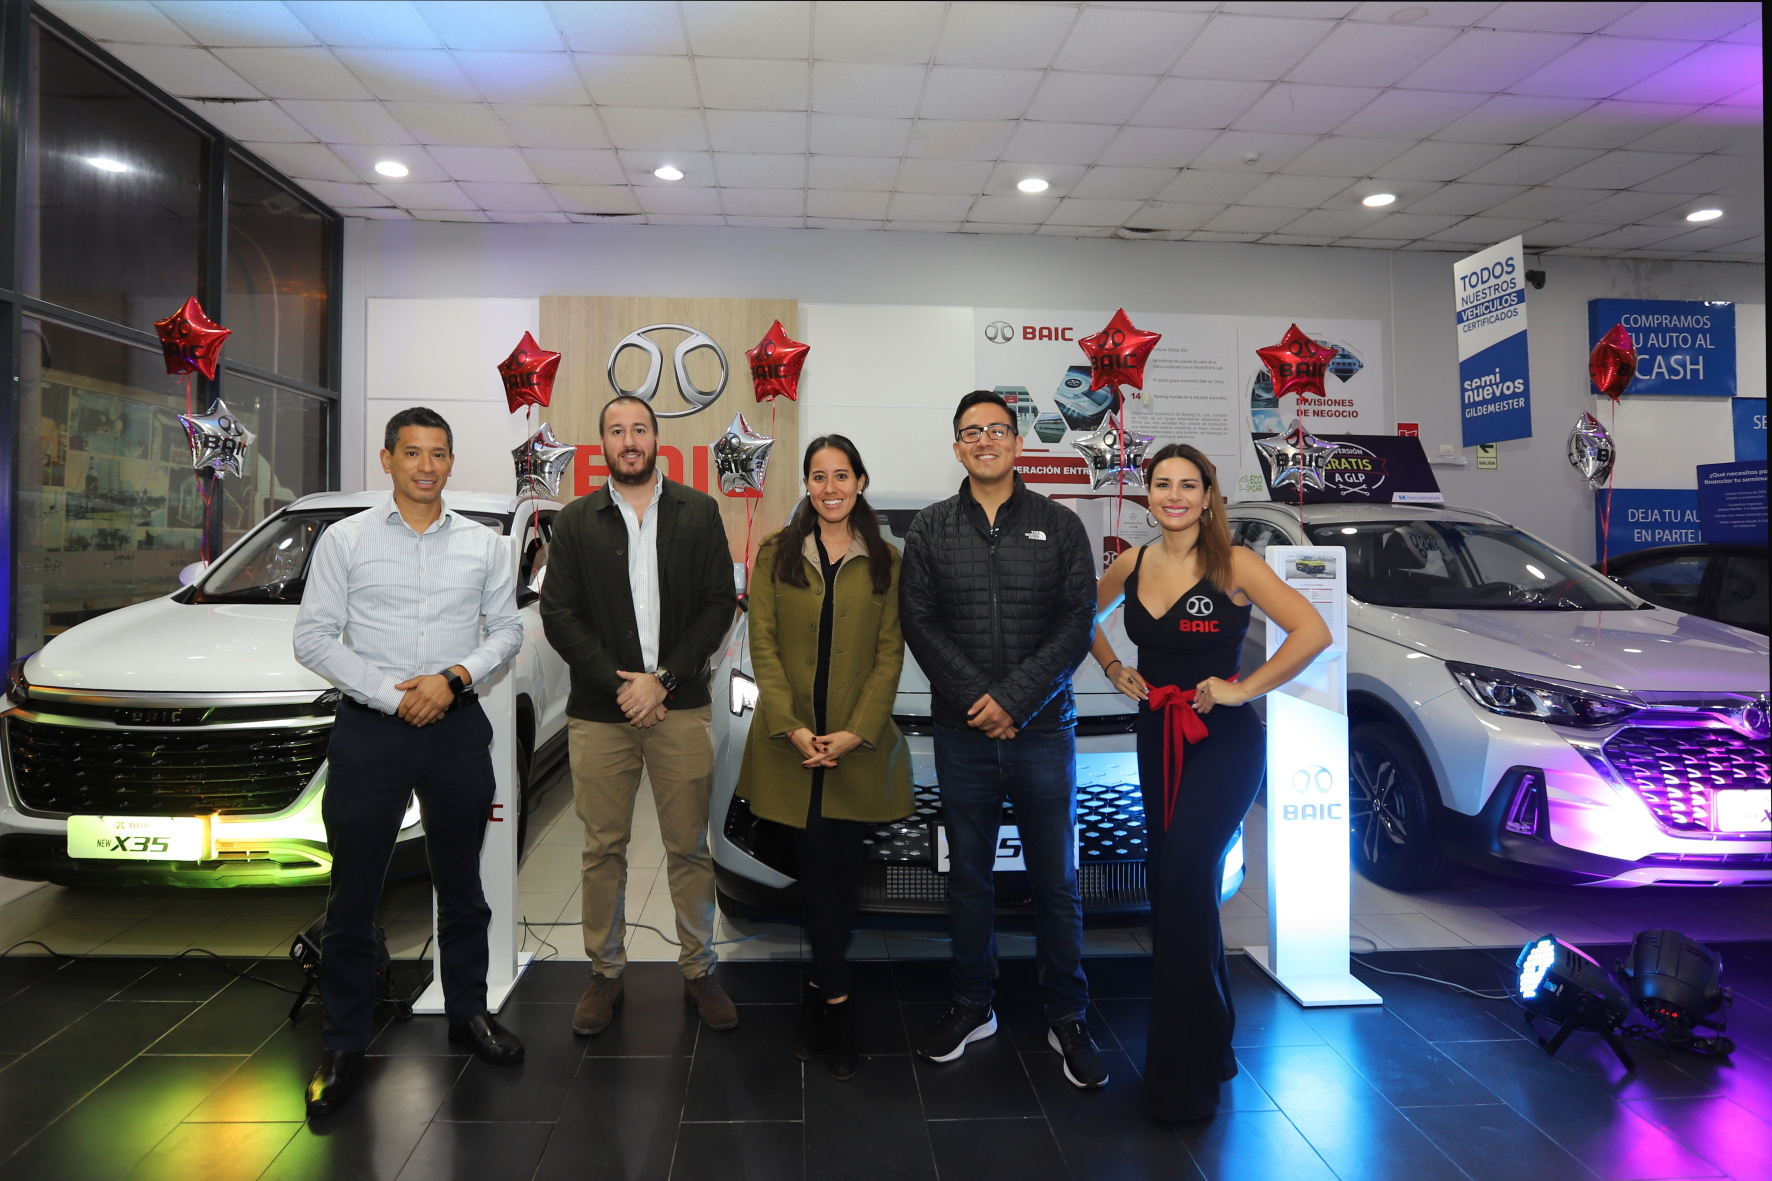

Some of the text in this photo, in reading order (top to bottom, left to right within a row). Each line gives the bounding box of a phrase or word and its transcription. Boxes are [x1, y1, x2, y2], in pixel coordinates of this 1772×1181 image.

[1460, 257, 1515, 292] TODOS
[1461, 277, 1517, 307] NUESTROS
[1461, 293, 1518, 321] VEHICULOS
[1462, 308, 1519, 333] CERTIFICADOS
[1621, 314, 1711, 328] COMPRAMOS
[1022, 325, 1074, 342] BAIC
[1647, 333, 1692, 348] AUTO
[1695, 334, 1715, 349] AL
[1090, 353, 1138, 371] BAIC
[1278, 362, 1326, 378] BAIC
[1636, 355, 1704, 380] CASH
[502, 372, 540, 390] AIC
[1464, 368, 1500, 390] semi
[1465, 379, 1524, 404] nuevos
[1296, 409, 1359, 419] DE NEGOCIO
[1465, 398, 1525, 418] GILDEMEISTER
[1753, 415, 1767, 430] SE
[1325, 458, 1372, 471] GRATIS
[1250, 475, 1263, 485] ECO
[1335, 473, 1366, 483] A GLP
[1709, 471, 1726, 479] ¿Qué
[1726, 469, 1758, 477] necesitas
[1628, 509, 1661, 522] DEJA
[1662, 509, 1680, 523] TU
[1634, 529, 1652, 542] EN
[1655, 529, 1696, 543] PARTE
[1179, 619, 1220, 633] BAIC
[1283, 803, 1342, 821] BAIC
[97, 836, 171, 853] NEW X35
